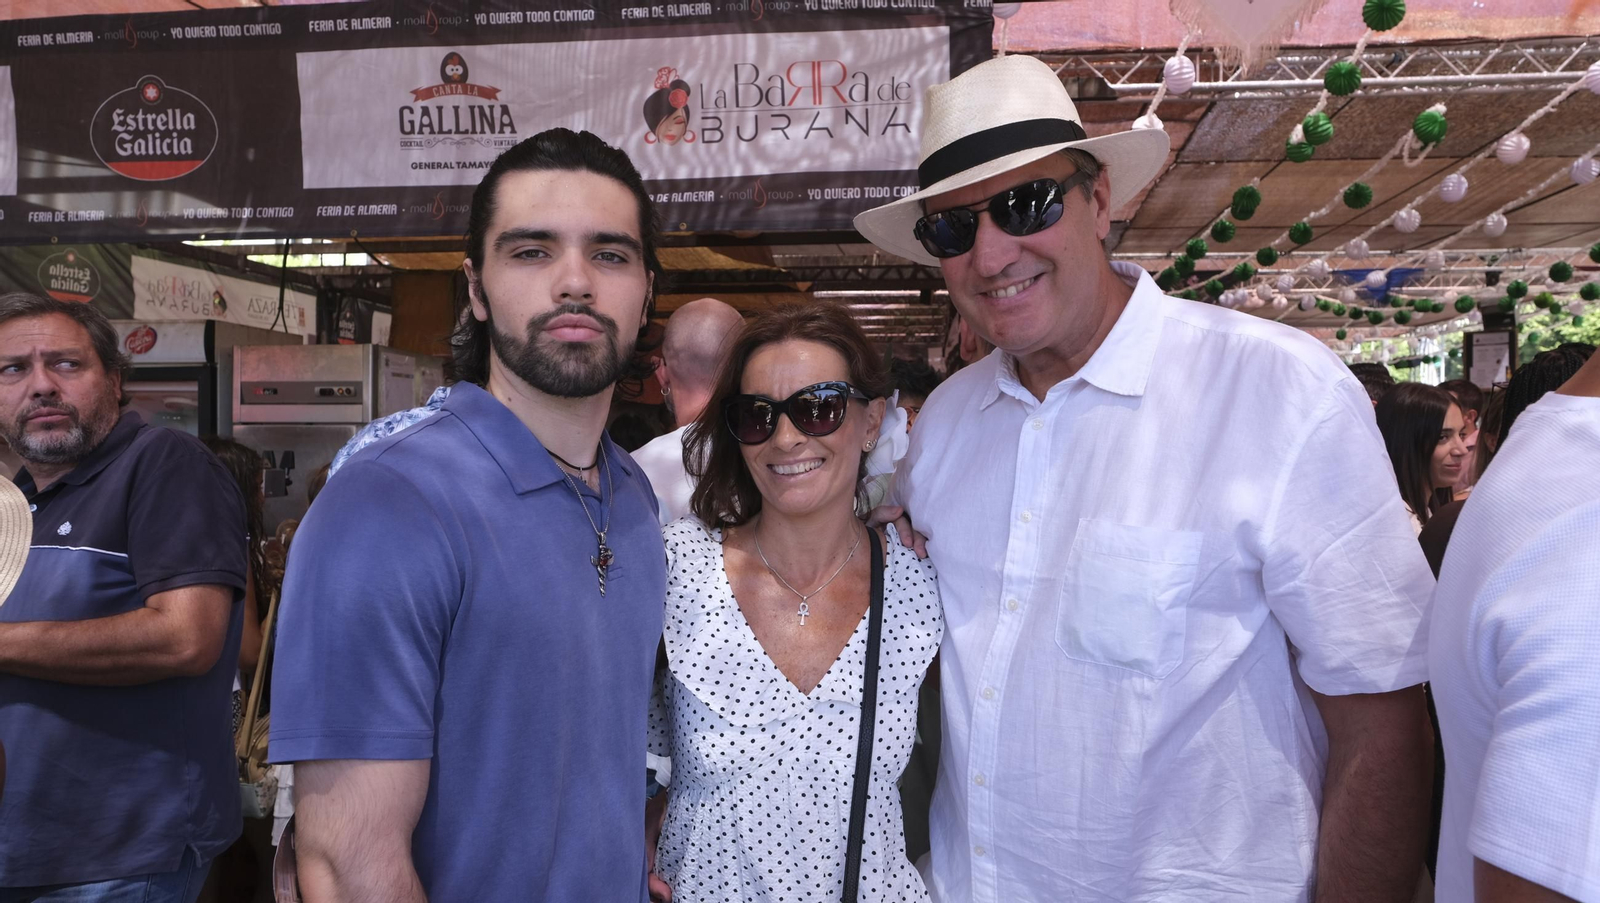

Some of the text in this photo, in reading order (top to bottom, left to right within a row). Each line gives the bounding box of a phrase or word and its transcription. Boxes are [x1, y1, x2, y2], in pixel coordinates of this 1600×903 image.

[309, 20, 334, 32] FERIA
[337, 18, 349, 31] DE
[351, 16, 391, 30] ALMERIA
[474, 13, 487, 25] YO
[489, 11, 523, 24] QUIERO
[526, 10, 550, 23] TODO
[553, 9, 595, 22] CONTIGO
[621, 7, 649, 19] FERIA
[652, 5, 664, 17] DE
[667, 2, 712, 16] ALMERIA
[805, 0, 818, 11] YO
[821, 0, 858, 10] QUIERO
[862, 0, 888, 8] TODO
[891, 0, 935, 8] CONTIGO
[17, 35, 41, 47] FERIA
[42, 33, 54, 45] DE
[56, 31, 94, 44] ALMERIA
[170, 27, 183, 39] YO
[185, 25, 217, 38] QUIERO
[218, 24, 241, 37] TODO
[243, 22, 282, 36] CONTIGO
[432, 84, 479, 97] CANTA LA
[700, 83, 727, 110] La
[877, 76, 911, 101] de
[111, 108, 196, 132] Estrella
[399, 104, 517, 135] GALLINA
[701, 106, 911, 143] BURANA
[115, 132, 193, 156] Galicia
[411, 161, 454, 170] GENERAL
[656, 193, 669, 203] DE
[671, 190, 715, 202] ALMERIA
[807, 188, 821, 200] YO
[824, 187, 860, 200] QUIERO
[864, 186, 890, 198] TODO
[893, 185, 920, 197] CONT
[28, 212, 53, 222] FERIA
[54, 211, 65, 222] DE
[67, 210, 105, 221] ALMERIA
[183, 208, 195, 219] YO
[197, 208, 228, 218] QUIERO
[231, 207, 253, 218] TODO
[256, 207, 294, 218] CONTIGO
[316, 206, 342, 217] FERIA
[343, 205, 356, 216] DE
[357, 204, 397, 215] ALMERIA
